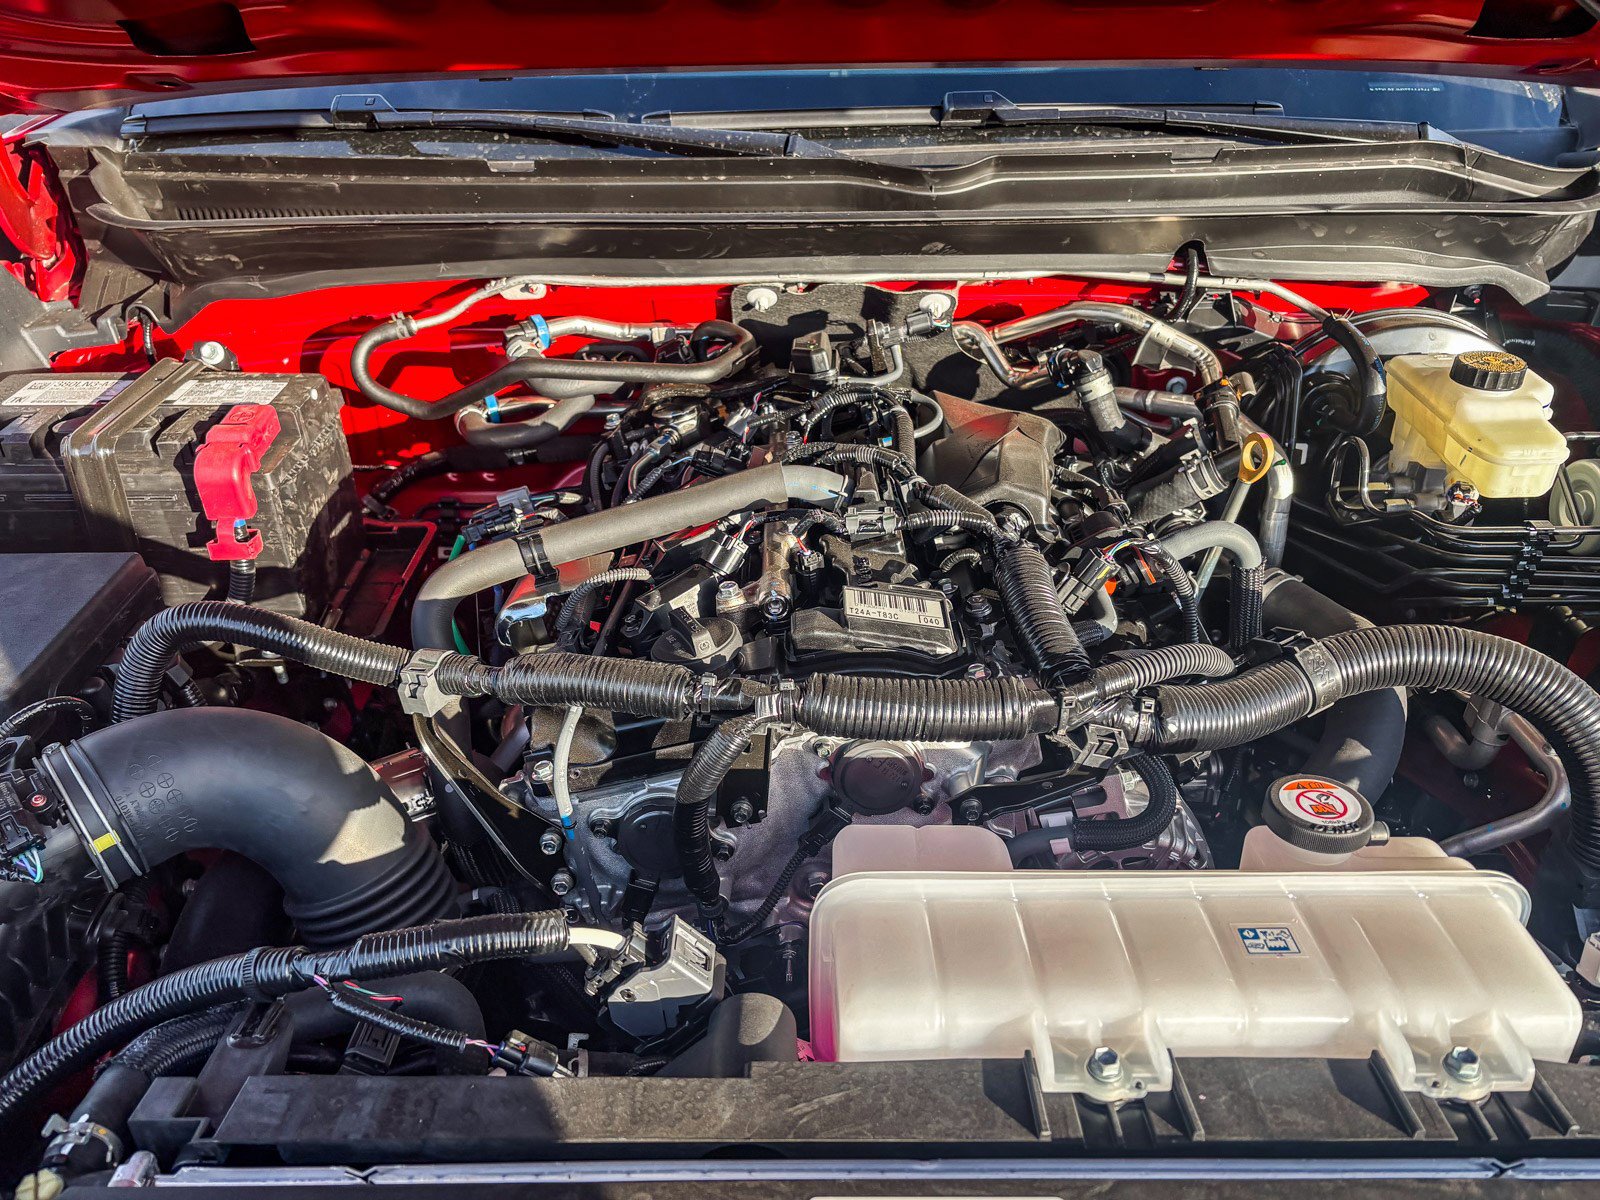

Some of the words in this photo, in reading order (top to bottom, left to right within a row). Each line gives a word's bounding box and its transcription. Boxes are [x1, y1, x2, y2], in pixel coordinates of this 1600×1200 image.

[849, 607, 899, 620] T24A-T83C
[924, 618, 940, 626] 040
[1310, 822, 1361, 834] DENSO
